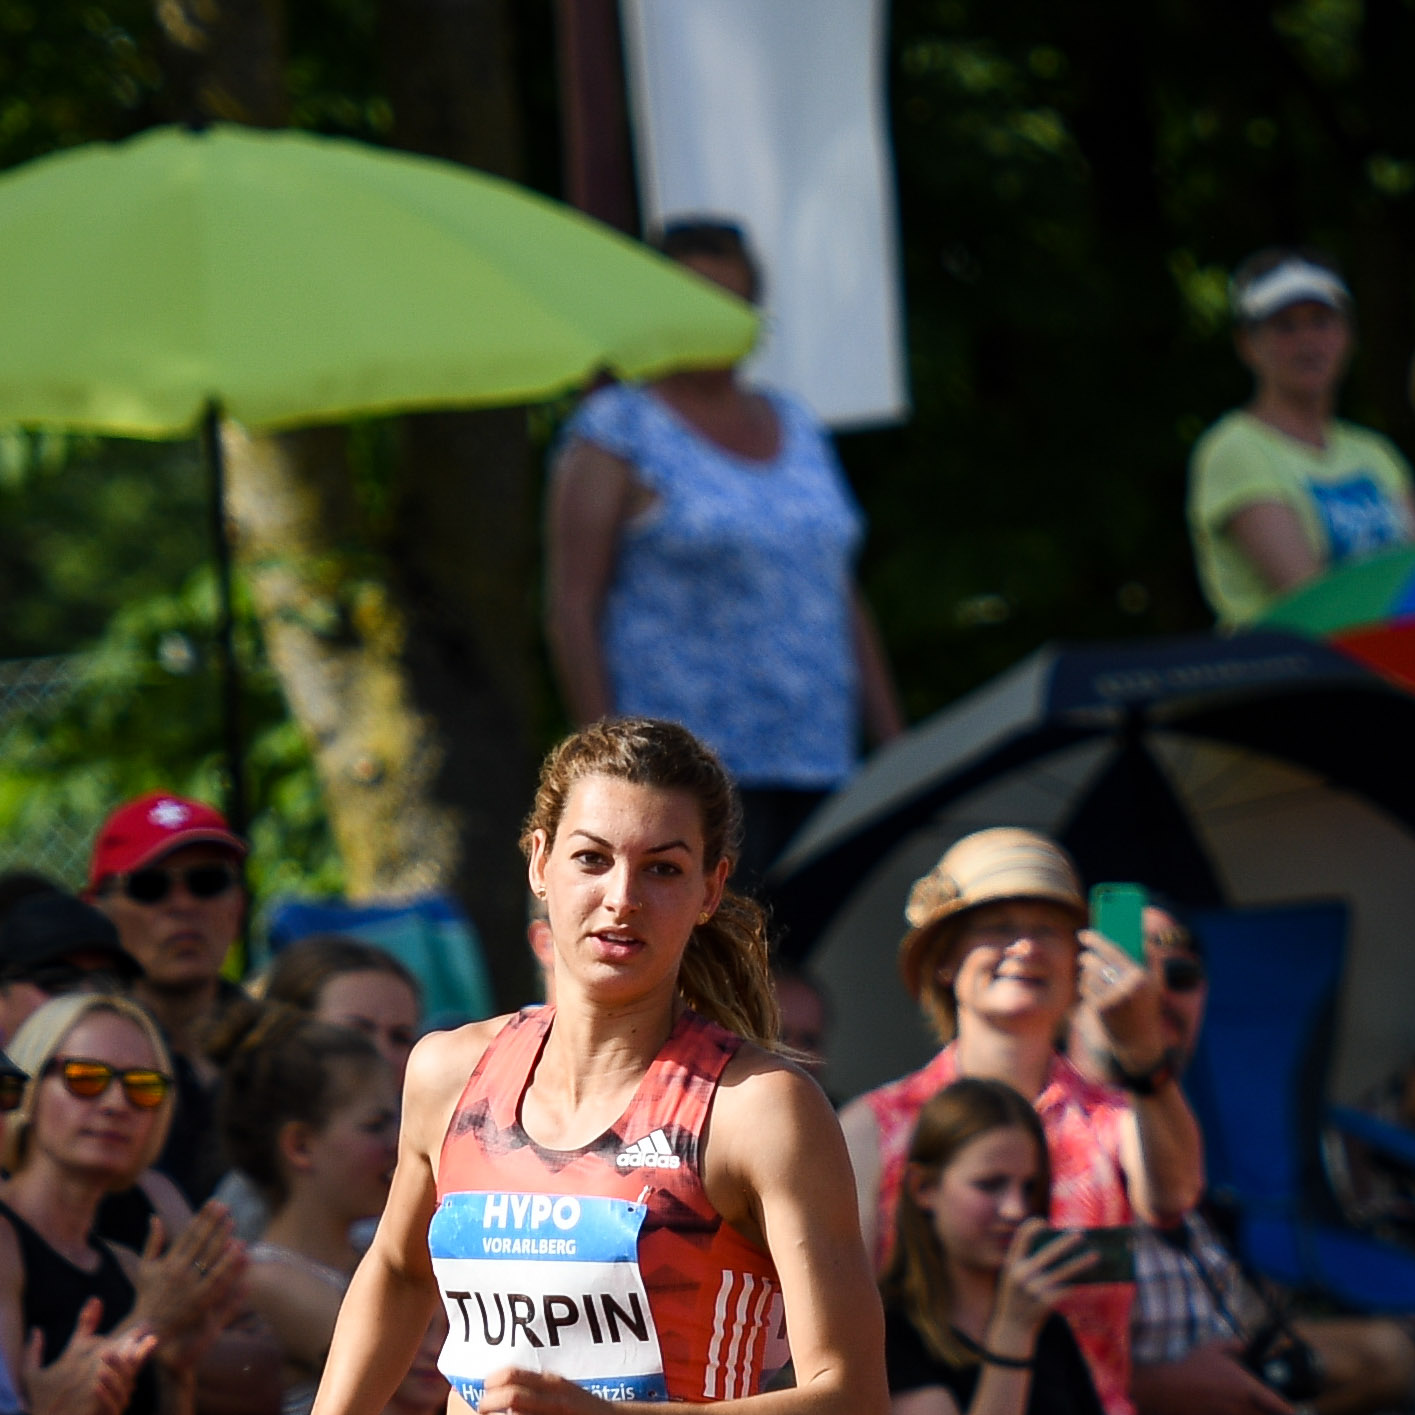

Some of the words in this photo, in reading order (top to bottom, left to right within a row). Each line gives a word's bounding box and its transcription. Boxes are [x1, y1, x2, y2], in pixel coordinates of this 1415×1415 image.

[616, 1151, 681, 1169] adidas
[482, 1194, 581, 1230] HYPO
[482, 1236, 577, 1255] VORARLBERG
[445, 1290, 650, 1348] TURPIN
[584, 1383, 636, 1402] ötzis
